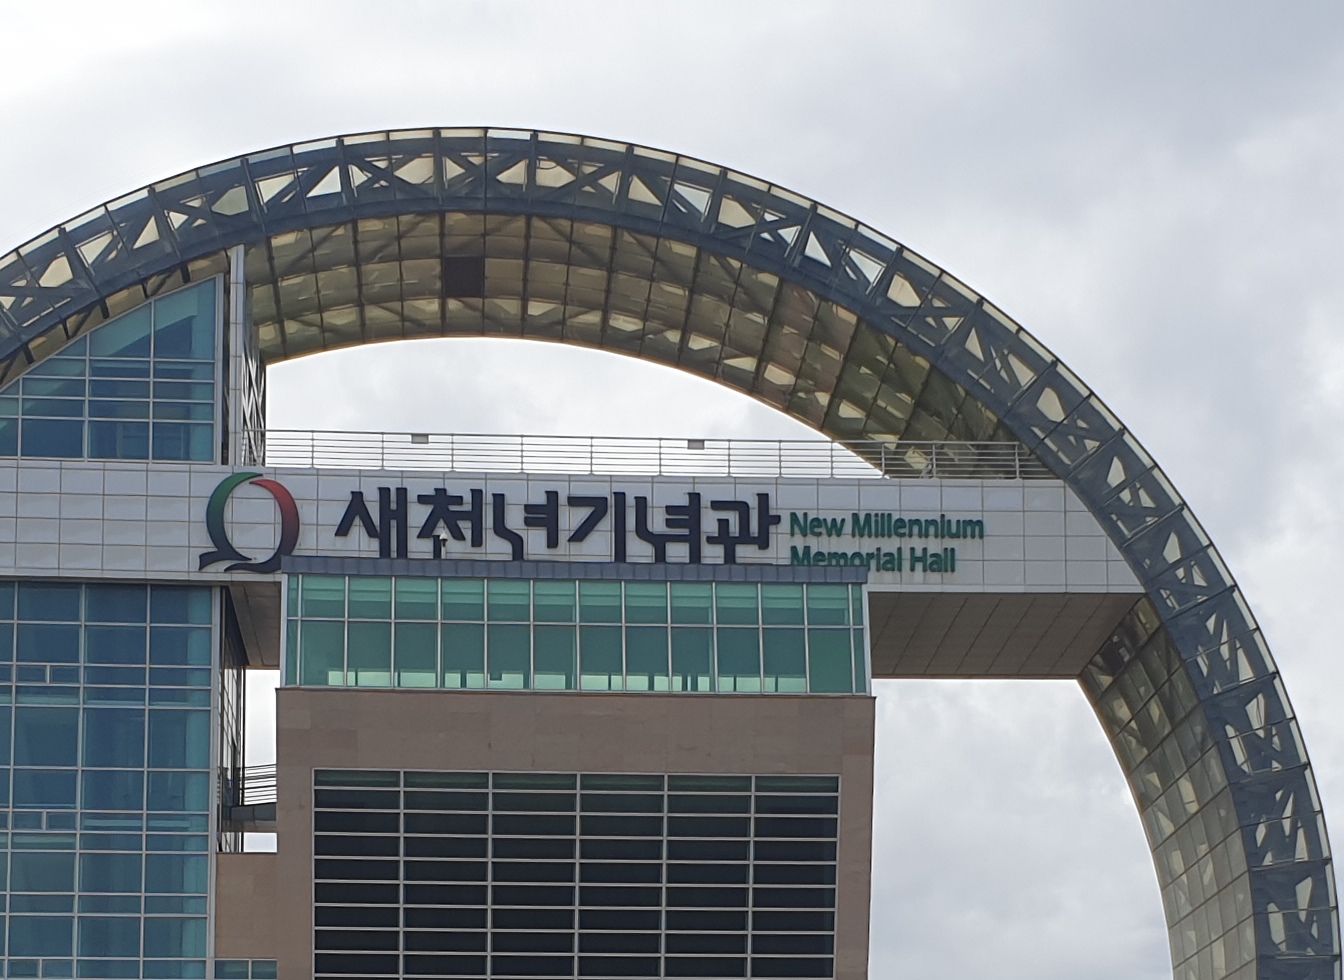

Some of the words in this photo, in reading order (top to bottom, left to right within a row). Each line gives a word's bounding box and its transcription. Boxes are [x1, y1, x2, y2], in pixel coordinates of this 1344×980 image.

[334, 487, 782, 564] 새천년기념관
[789, 512, 846, 538] New
[851, 512, 985, 539] Millennium
[790, 545, 902, 573] Memorial
[909, 546, 956, 573] Hall
